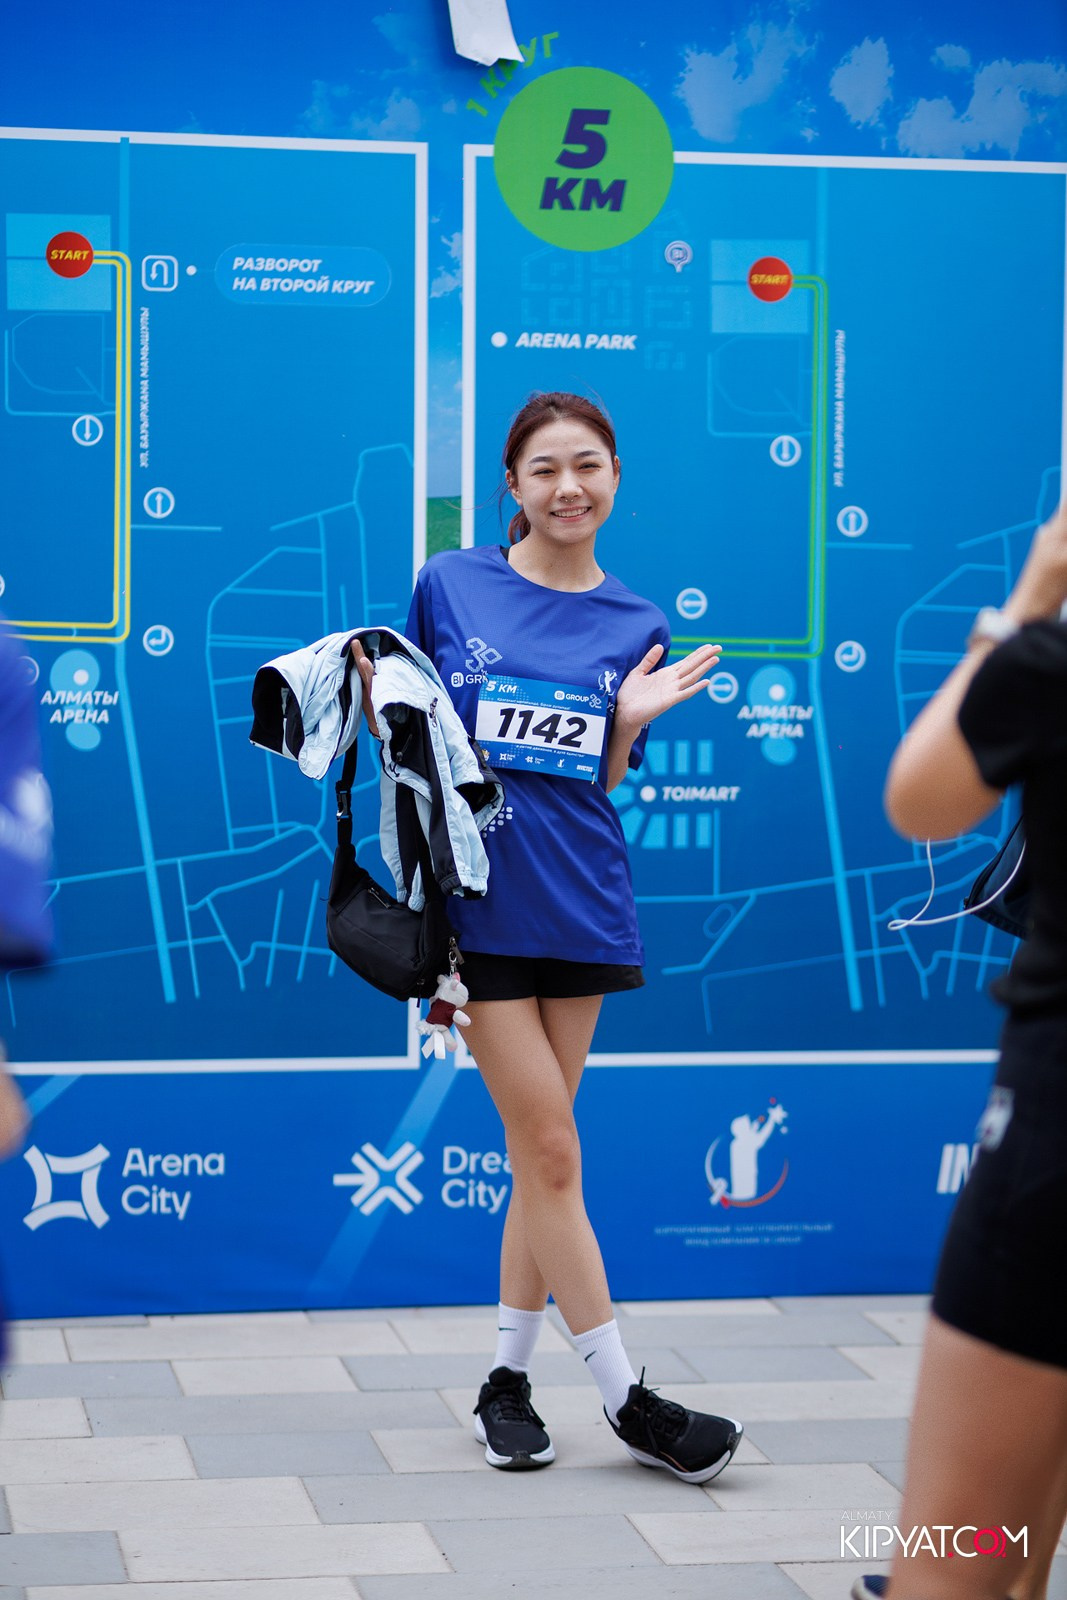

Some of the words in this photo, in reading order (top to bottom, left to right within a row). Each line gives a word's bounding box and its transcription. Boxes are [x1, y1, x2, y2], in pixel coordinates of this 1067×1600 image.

[466, 98, 488, 117] 1
[555, 108, 612, 170] 5
[50, 249, 89, 261] START
[232, 257, 322, 274] РАЗВОРОТ
[232, 278, 258, 292] НА
[260, 276, 328, 294] ВТОРОЙ
[331, 280, 375, 295] КРУГ
[750, 274, 790, 285] START
[515, 332, 581, 349] ARENA
[584, 334, 638, 350] PARK
[486, 680, 496, 692] 5
[40, 690, 120, 706] АЛМАТЫ
[566, 693, 590, 703] GROUP
[50, 709, 110, 724] АРЕНА
[736, 705, 814, 720] АЛМАТЫ
[496, 708, 588, 748] 1142
[746, 724, 804, 738] АРЕНА
[662, 786, 740, 802] TOIMART
[122, 1147, 225, 1177] Arena
[121, 1184, 192, 1220] City
[441, 1178, 508, 1214] City
